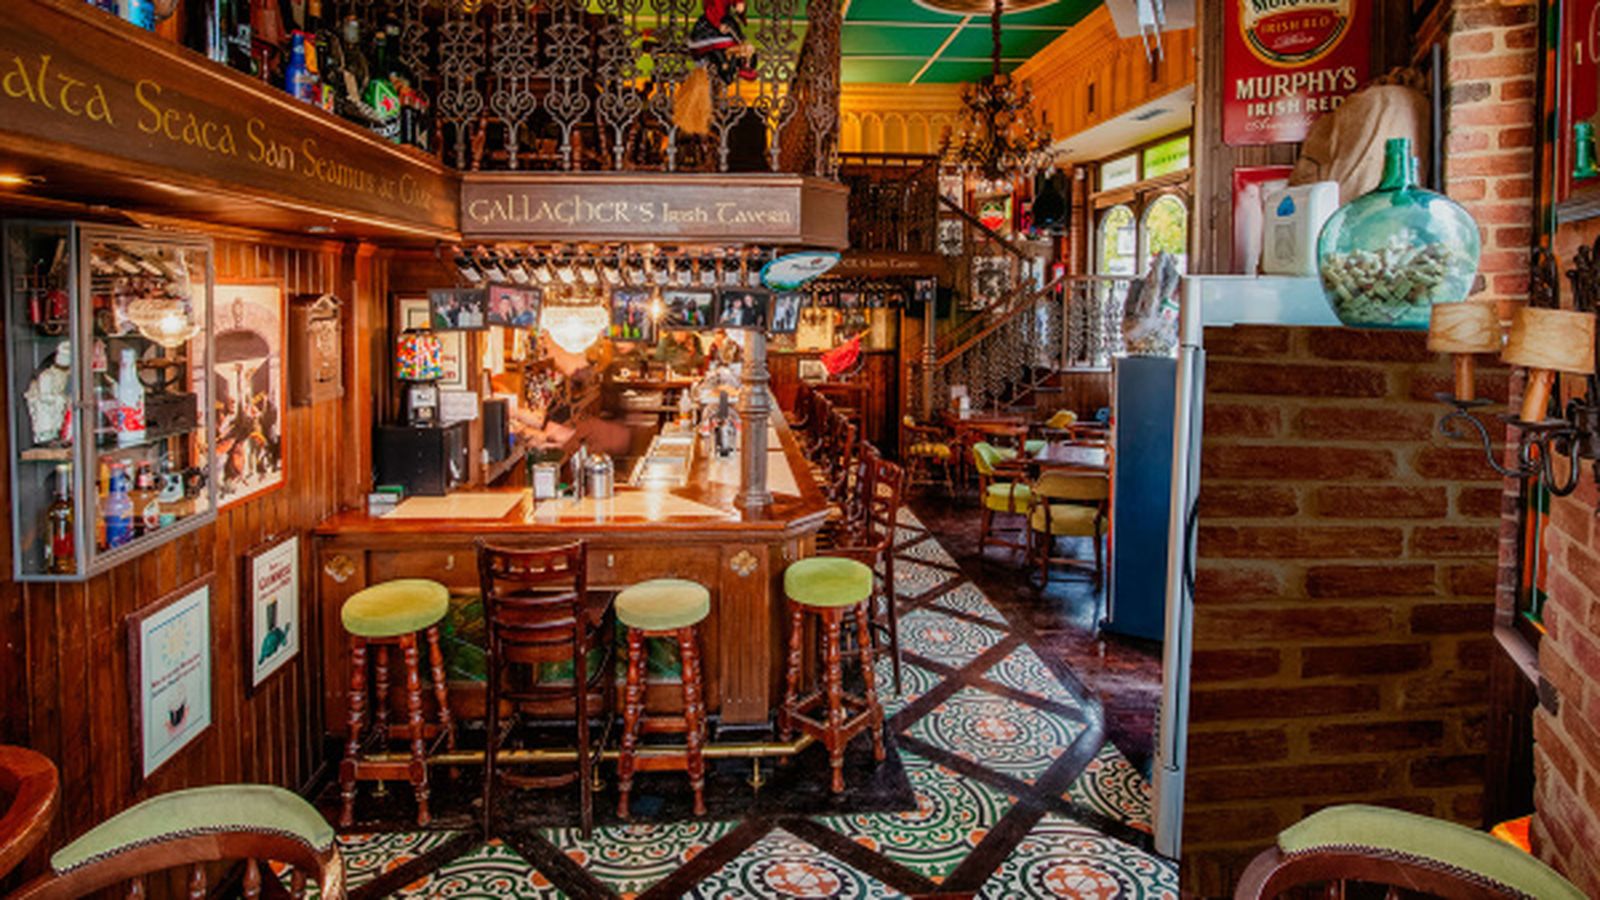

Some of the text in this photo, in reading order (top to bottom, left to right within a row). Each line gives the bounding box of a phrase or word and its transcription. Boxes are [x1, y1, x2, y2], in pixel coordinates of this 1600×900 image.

[1260, 19, 1300, 34] IRISH
[1235, 65, 1358, 101] MURPHY'S
[1246, 95, 1345, 118] IRISH RED
[134, 79, 238, 156] Seaca
[247, 117, 295, 172] San
[662, 202, 709, 223] Irish
[715, 201, 791, 225] Tavern
